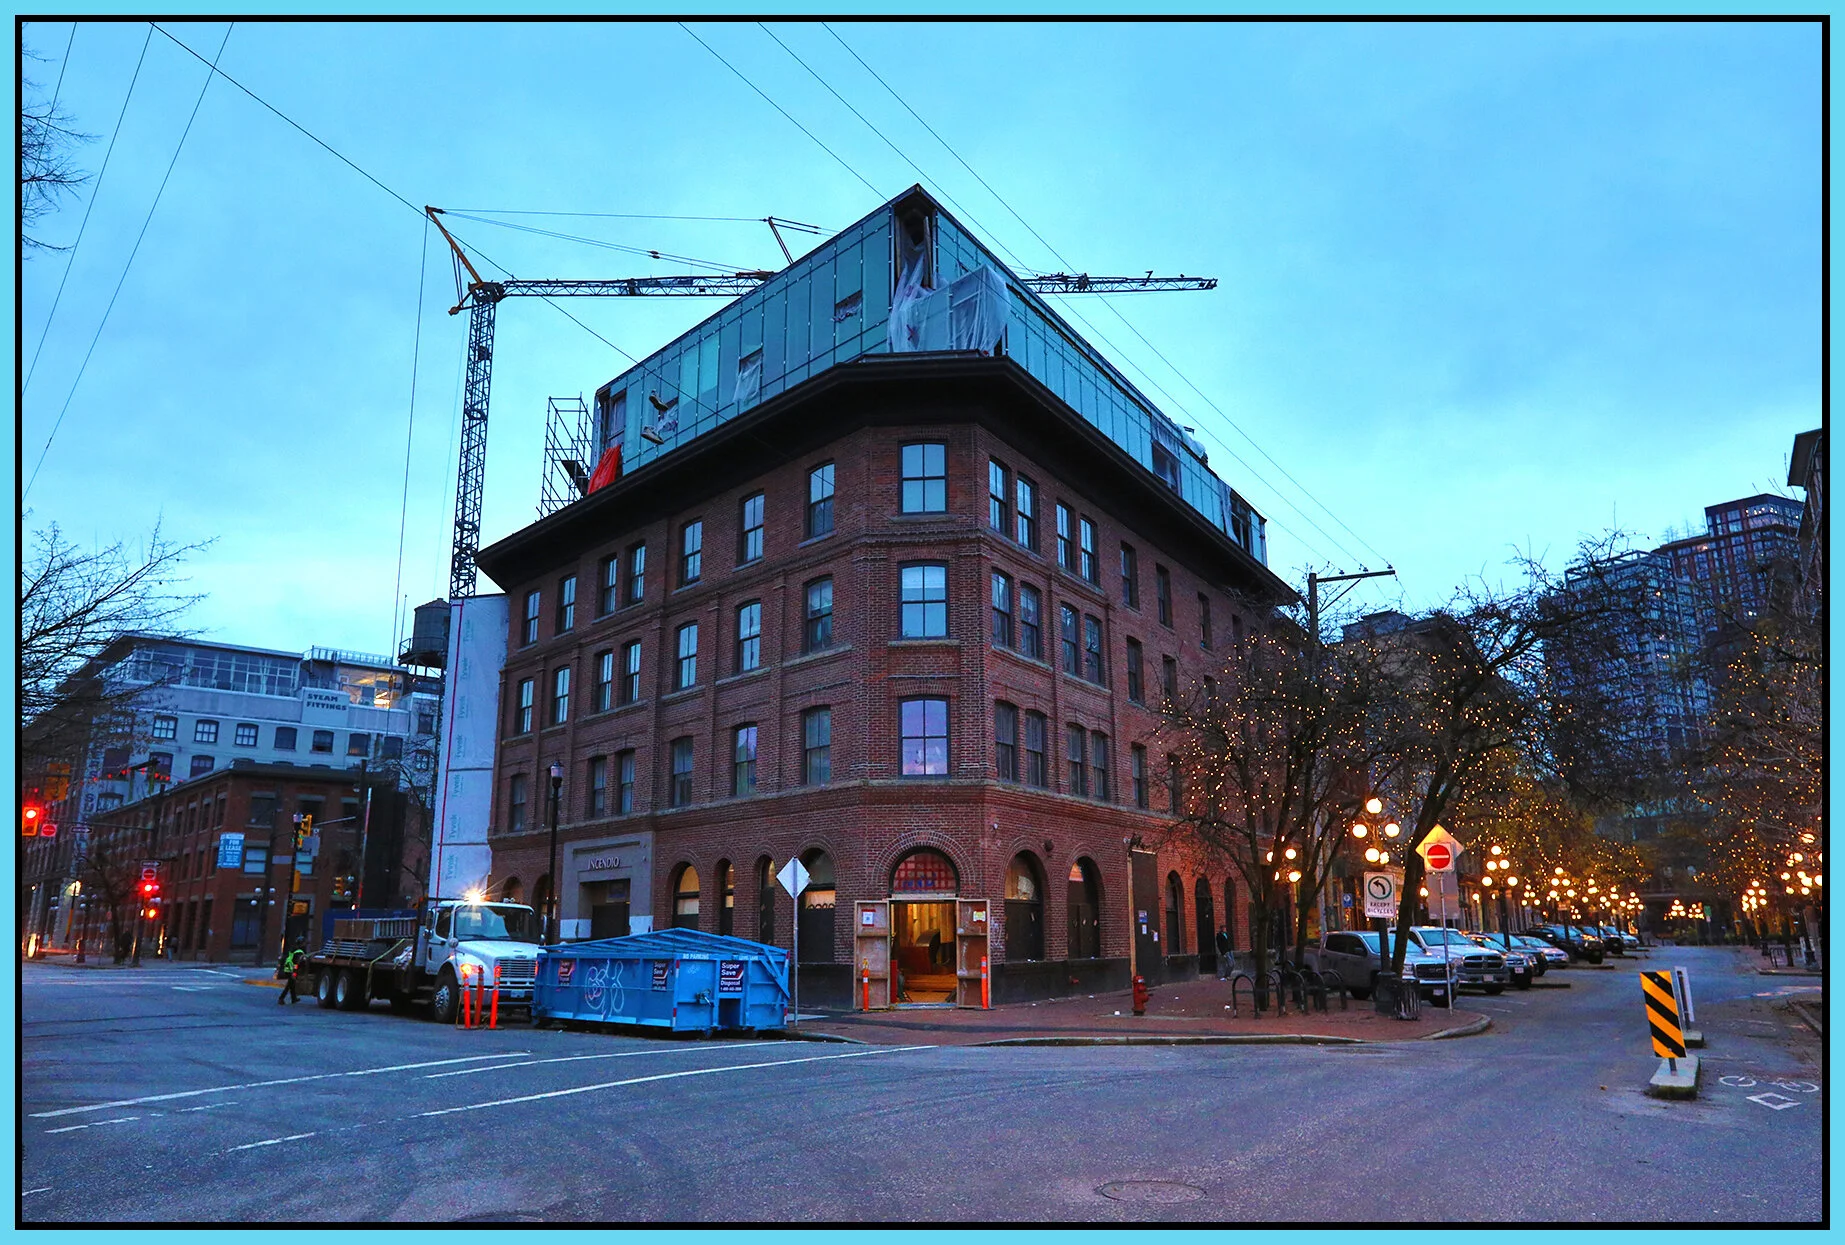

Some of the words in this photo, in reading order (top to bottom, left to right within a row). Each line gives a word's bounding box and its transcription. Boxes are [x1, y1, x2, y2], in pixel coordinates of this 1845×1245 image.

[308, 694, 338, 702] STEAM
[306, 701, 347, 711] FITTINGS
[588, 857, 620, 870] INCENDIO
[721, 962, 740, 970] Super
